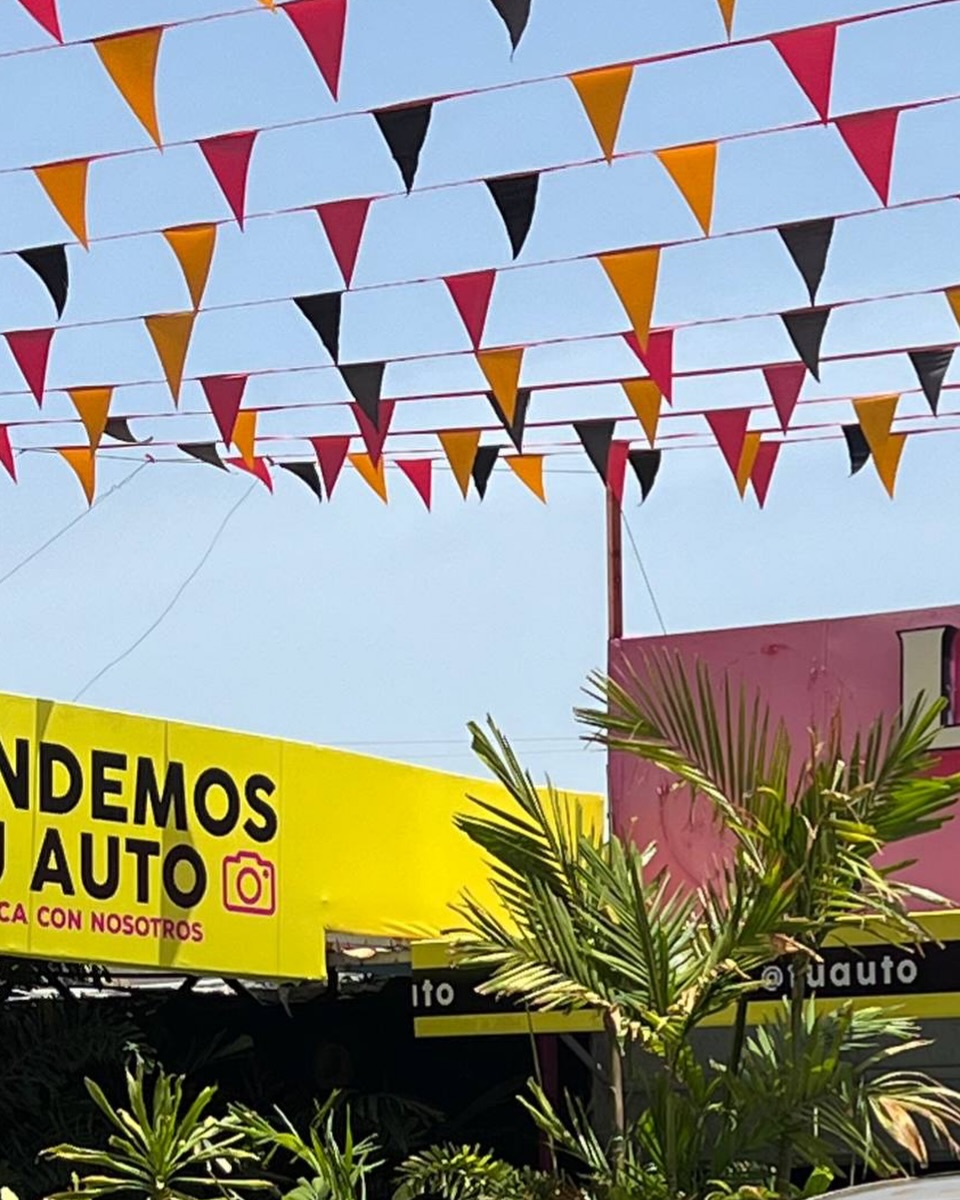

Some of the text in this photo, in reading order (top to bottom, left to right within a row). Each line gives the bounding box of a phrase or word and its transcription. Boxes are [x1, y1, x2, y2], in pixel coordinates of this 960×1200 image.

[0, 737, 278, 842] NDEMOS
[30, 827, 208, 909] AUTO
[37, 906, 82, 930] CON
[91, 911, 204, 942] NOSOTROS
